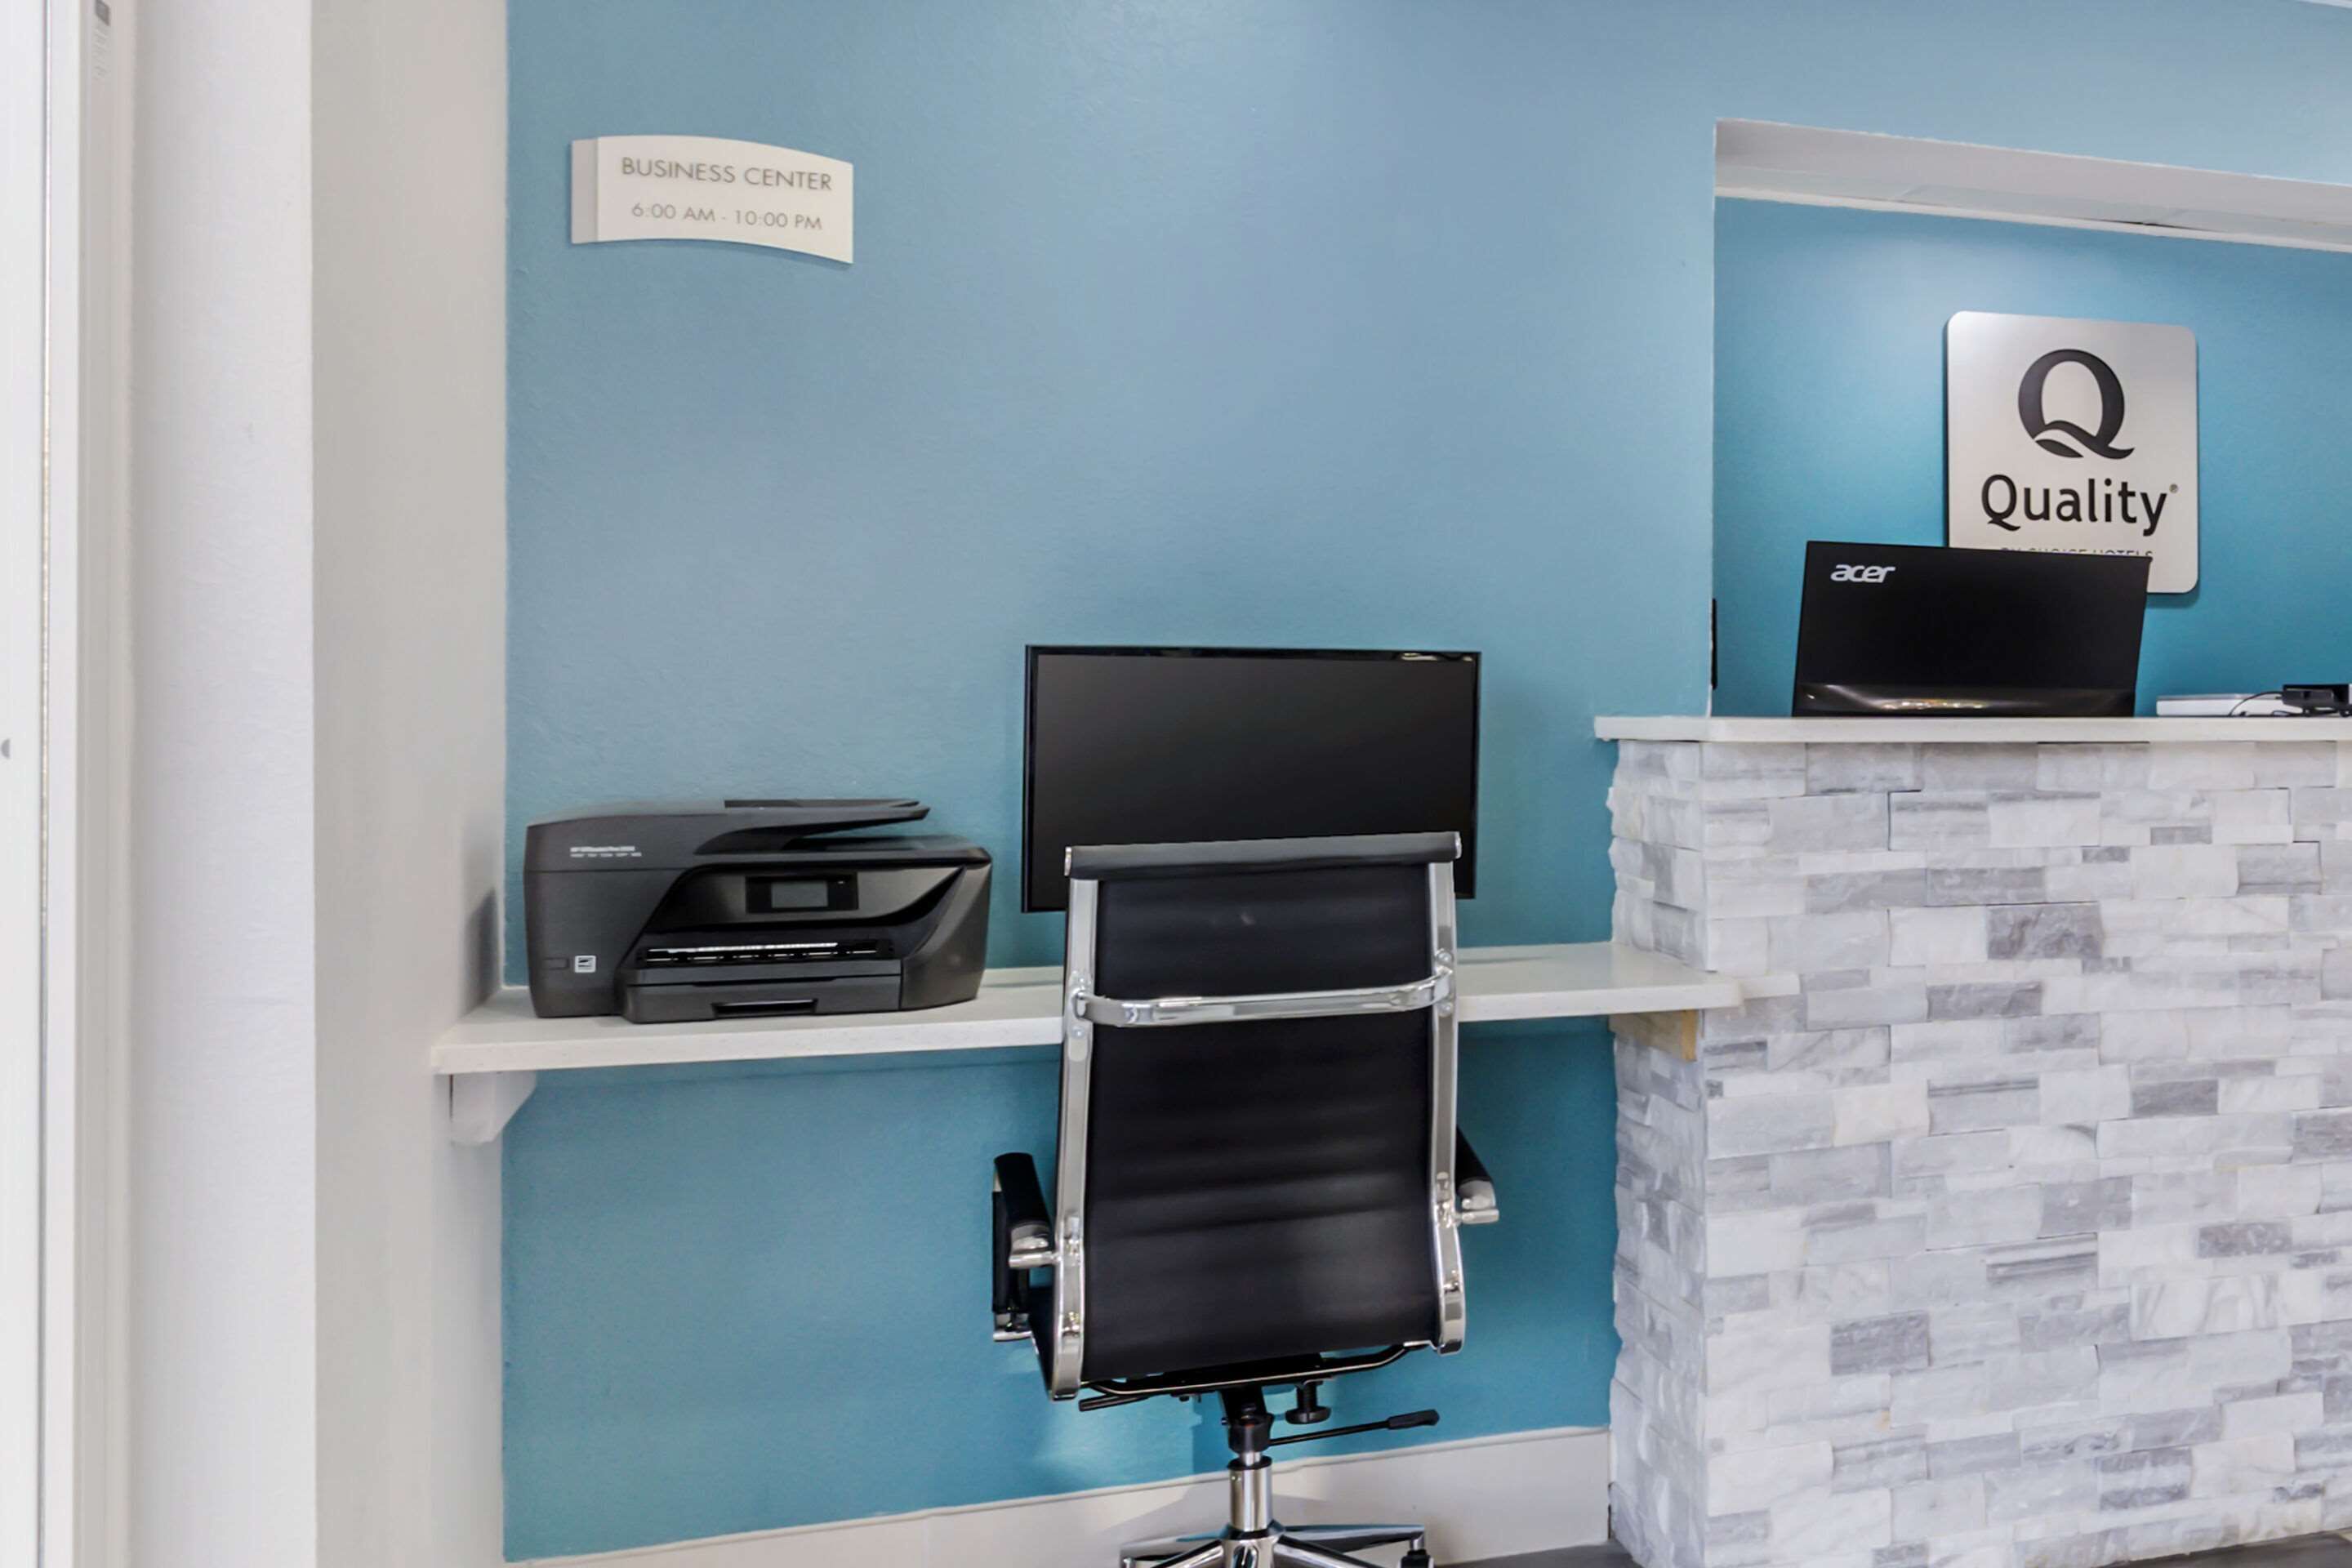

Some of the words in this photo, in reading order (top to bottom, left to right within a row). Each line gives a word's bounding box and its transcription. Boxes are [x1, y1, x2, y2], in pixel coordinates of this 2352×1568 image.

[621, 156, 736, 184] BUSINESS
[743, 166, 833, 191] CENTER
[631, 202, 677, 220] 6:00
[683, 206, 716, 222] AM
[734, 209, 789, 228] 10:00
[794, 213, 823, 230] PM
[2018, 349, 2136, 460] Q
[1981, 474, 2167, 537] Quality
[1830, 564, 1896, 583] acer
